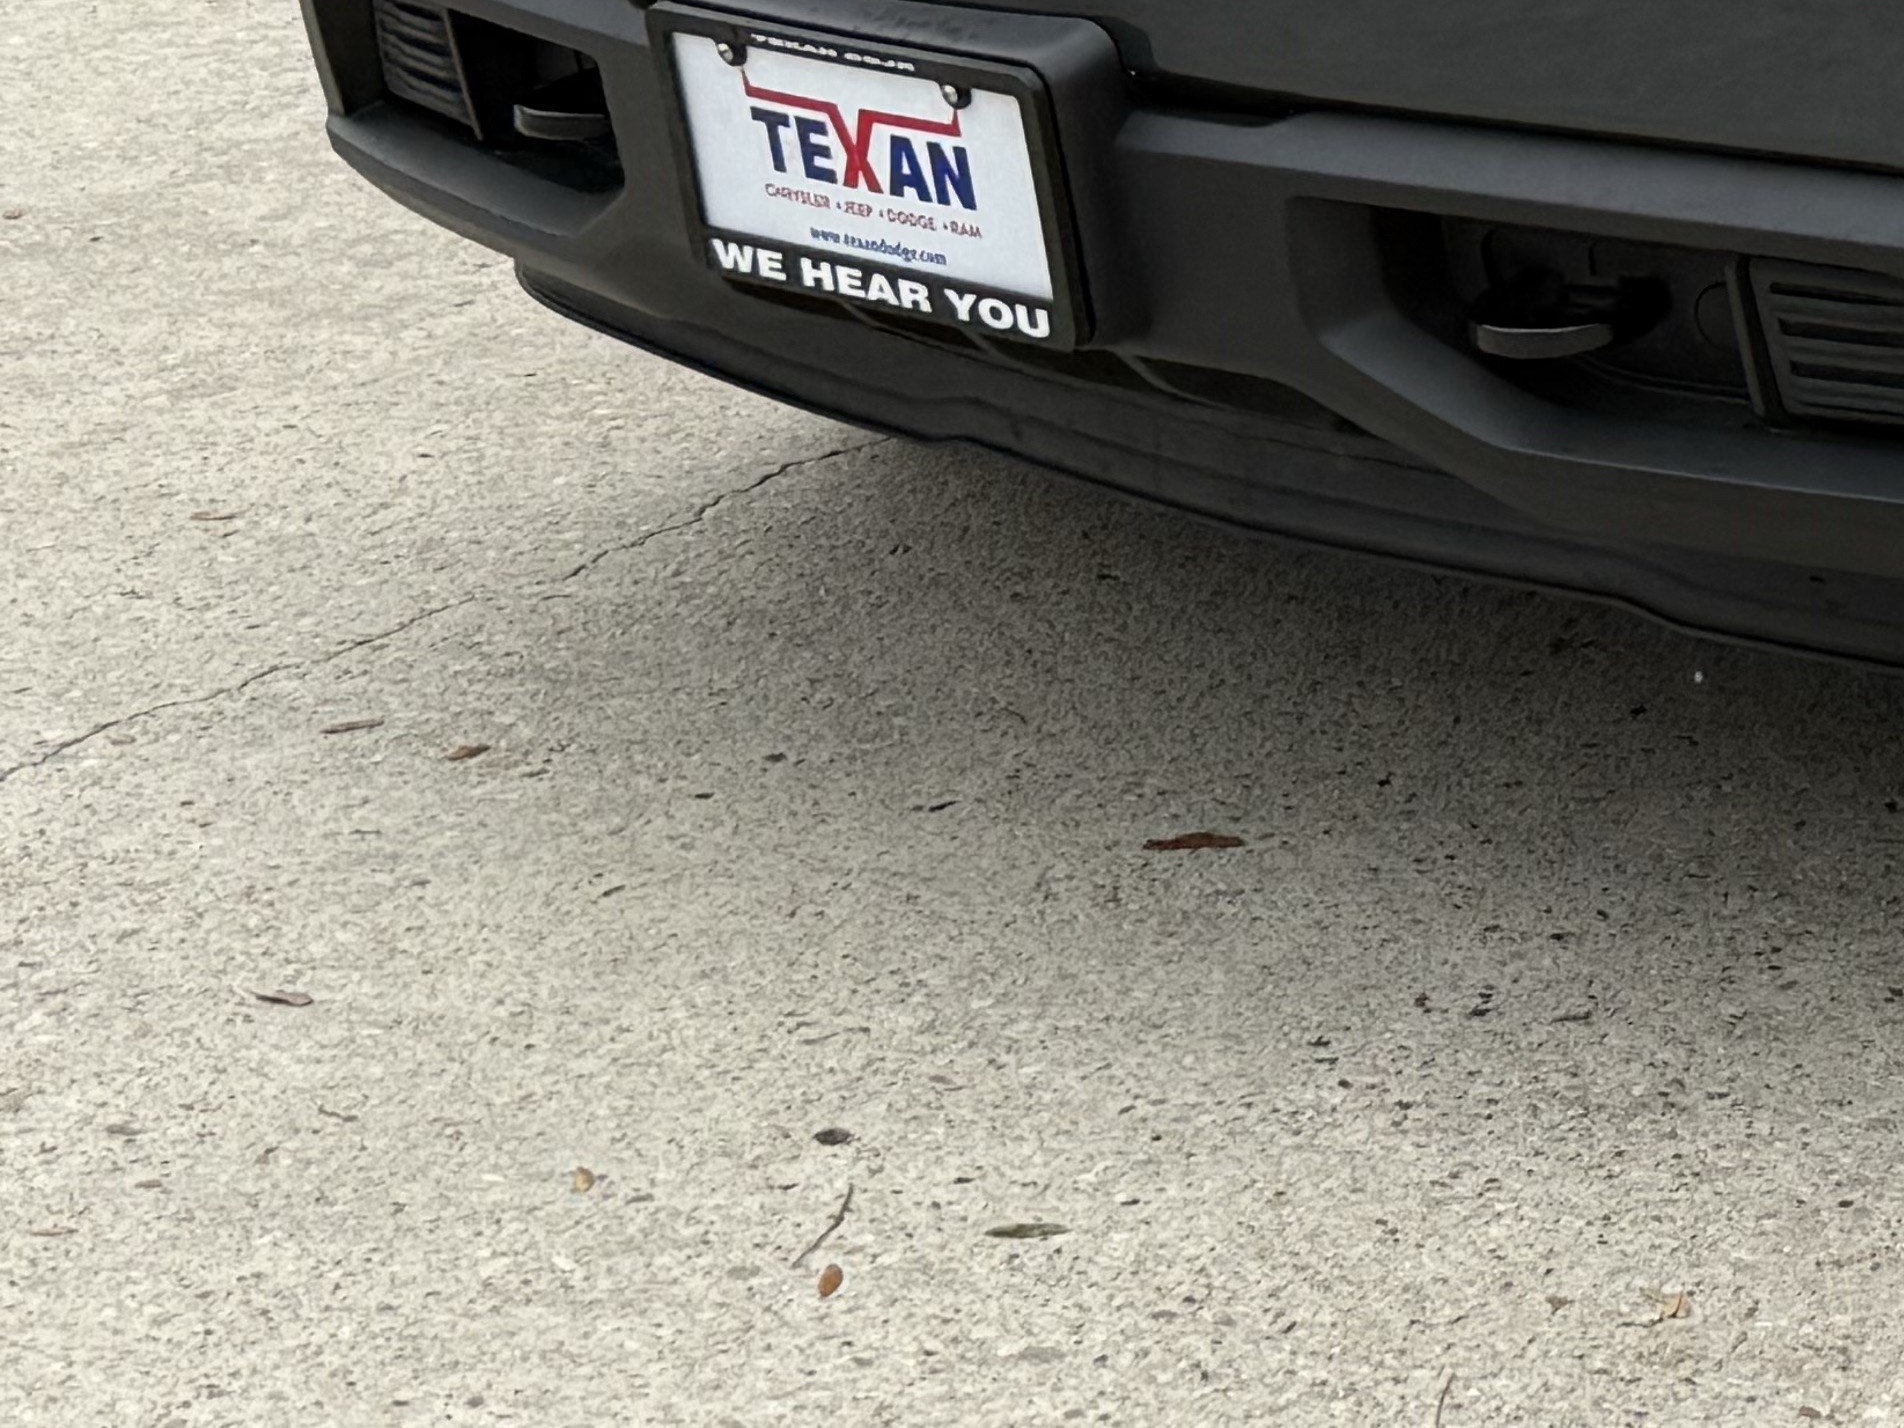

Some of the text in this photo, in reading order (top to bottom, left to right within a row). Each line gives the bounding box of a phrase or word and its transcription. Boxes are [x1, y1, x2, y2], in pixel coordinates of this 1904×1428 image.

[750, 103, 977, 211] TEXAN
[887, 208, 936, 231] DODGE
[950, 220, 983, 239] RAM
[711, 239, 1050, 340] WE HEAR YOU
